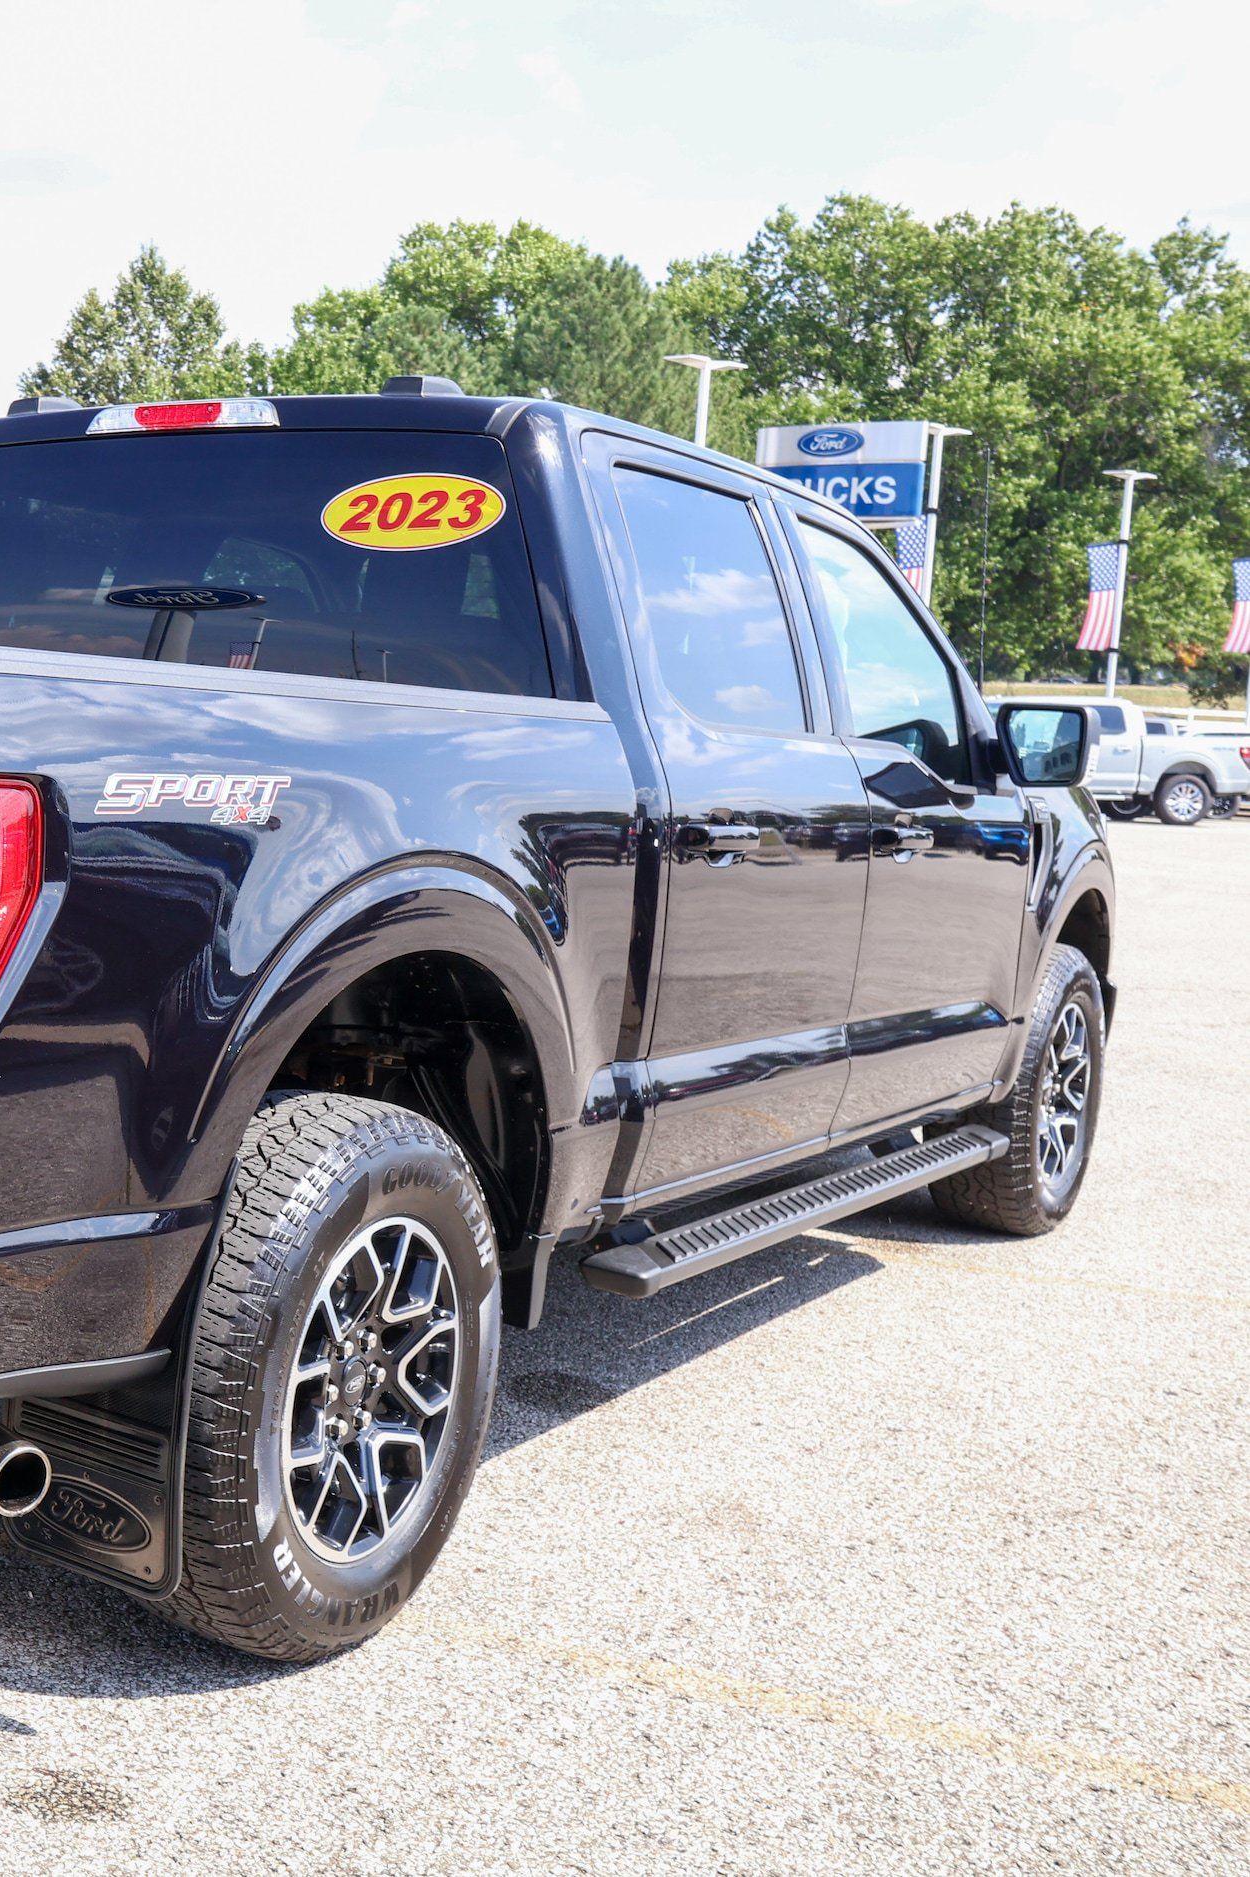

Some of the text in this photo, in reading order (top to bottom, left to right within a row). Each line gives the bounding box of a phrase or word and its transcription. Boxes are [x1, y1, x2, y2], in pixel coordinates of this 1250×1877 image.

[809, 433, 847, 451] Ford
[339, 489, 488, 532] 2023
[94, 773, 291, 814] SPORT
[51, 1486, 126, 1543] Ford
